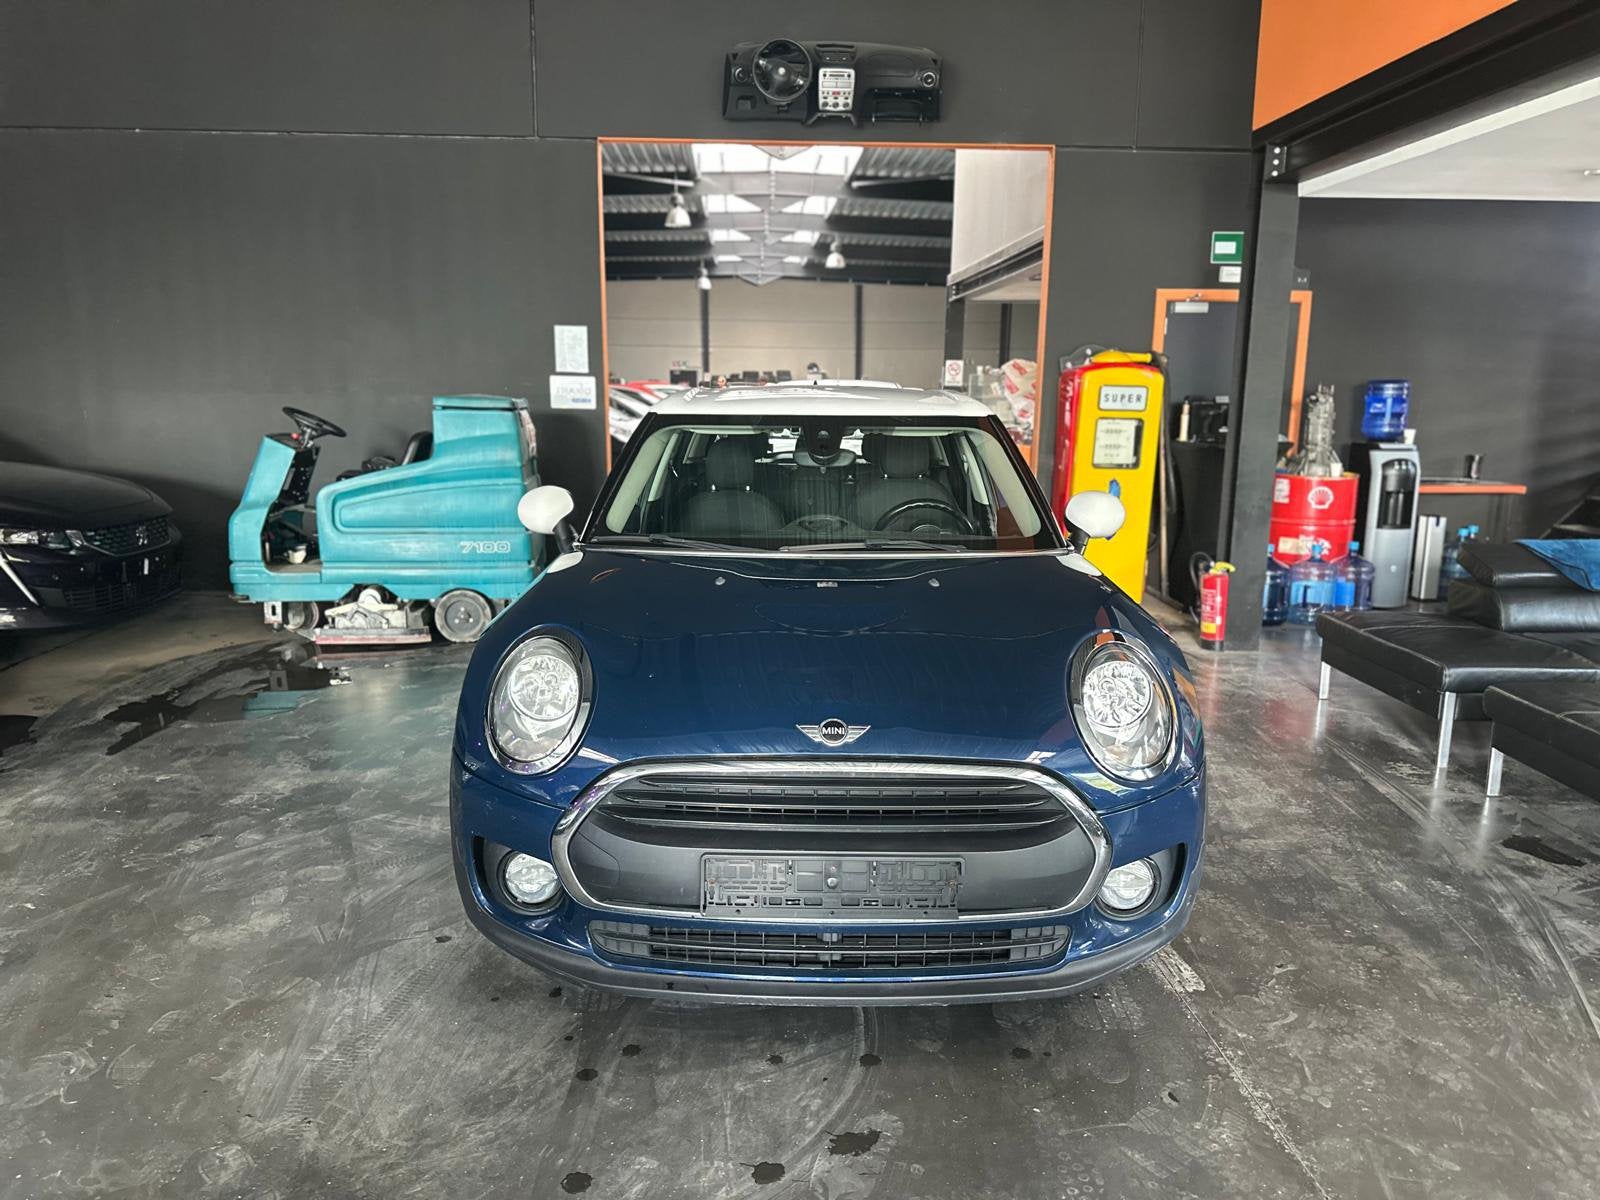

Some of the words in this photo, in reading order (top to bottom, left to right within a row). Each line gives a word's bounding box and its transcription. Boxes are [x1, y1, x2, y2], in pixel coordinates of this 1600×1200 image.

[1104, 394, 1142, 403] SUPER
[460, 540, 511, 554] 7100
[822, 726, 845, 735] MINI
